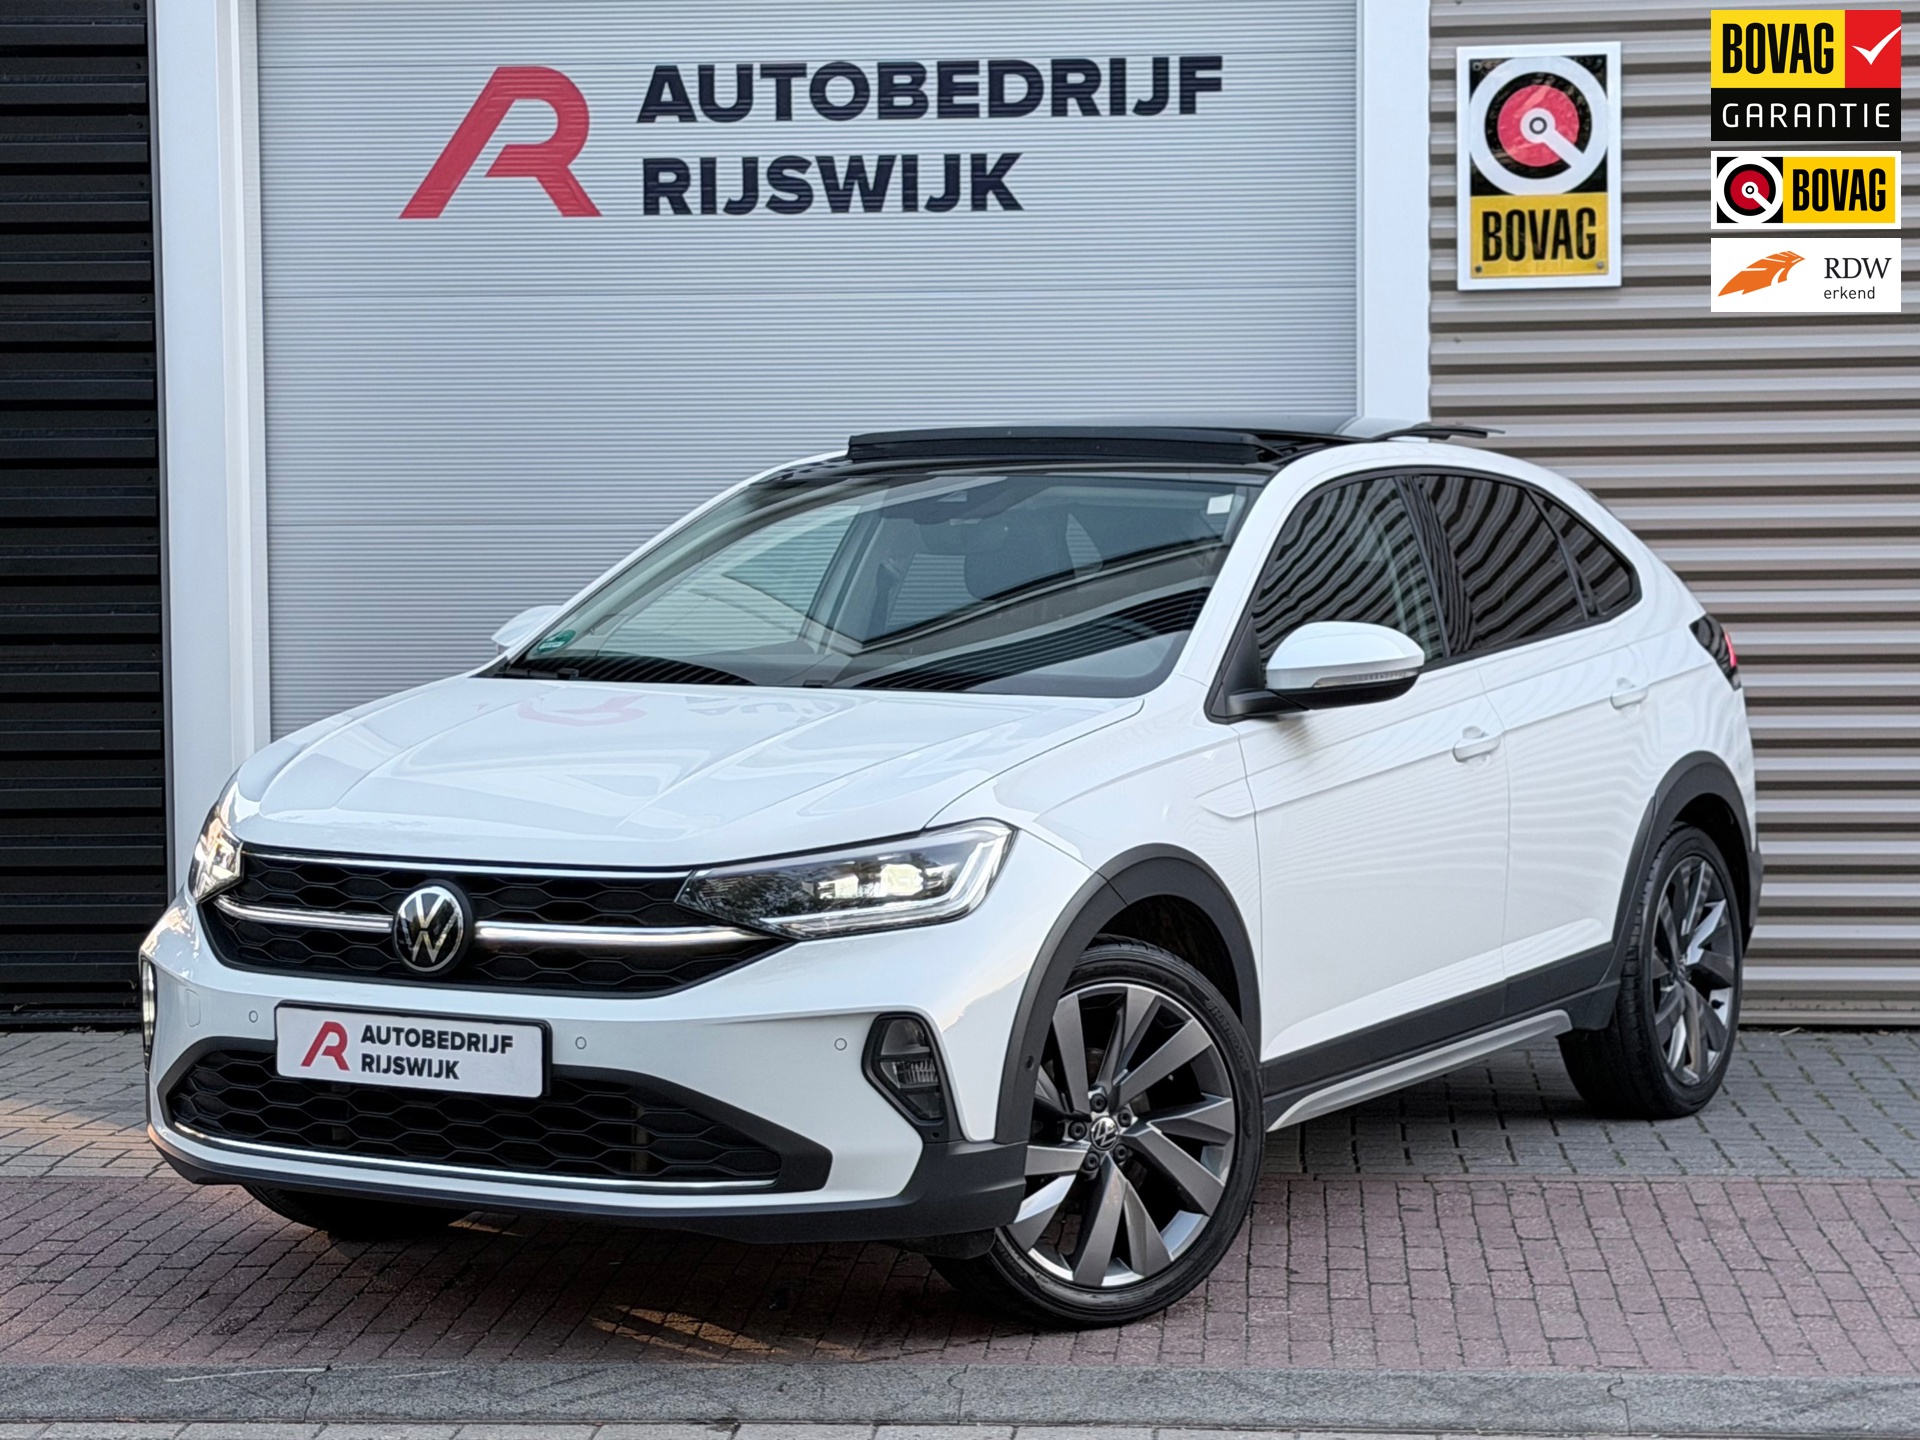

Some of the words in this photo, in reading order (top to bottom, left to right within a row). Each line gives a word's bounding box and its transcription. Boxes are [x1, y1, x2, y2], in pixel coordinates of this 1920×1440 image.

[636, 56, 1223, 123] AUTOBEDRIJF
[642, 152, 1024, 216] RIJSWIJK
[1482, 207, 1596, 262] BOVAG
[360, 1024, 514, 1055] AUTOBEDRIJF
[360, 1052, 460, 1080] RIJSWIJK
